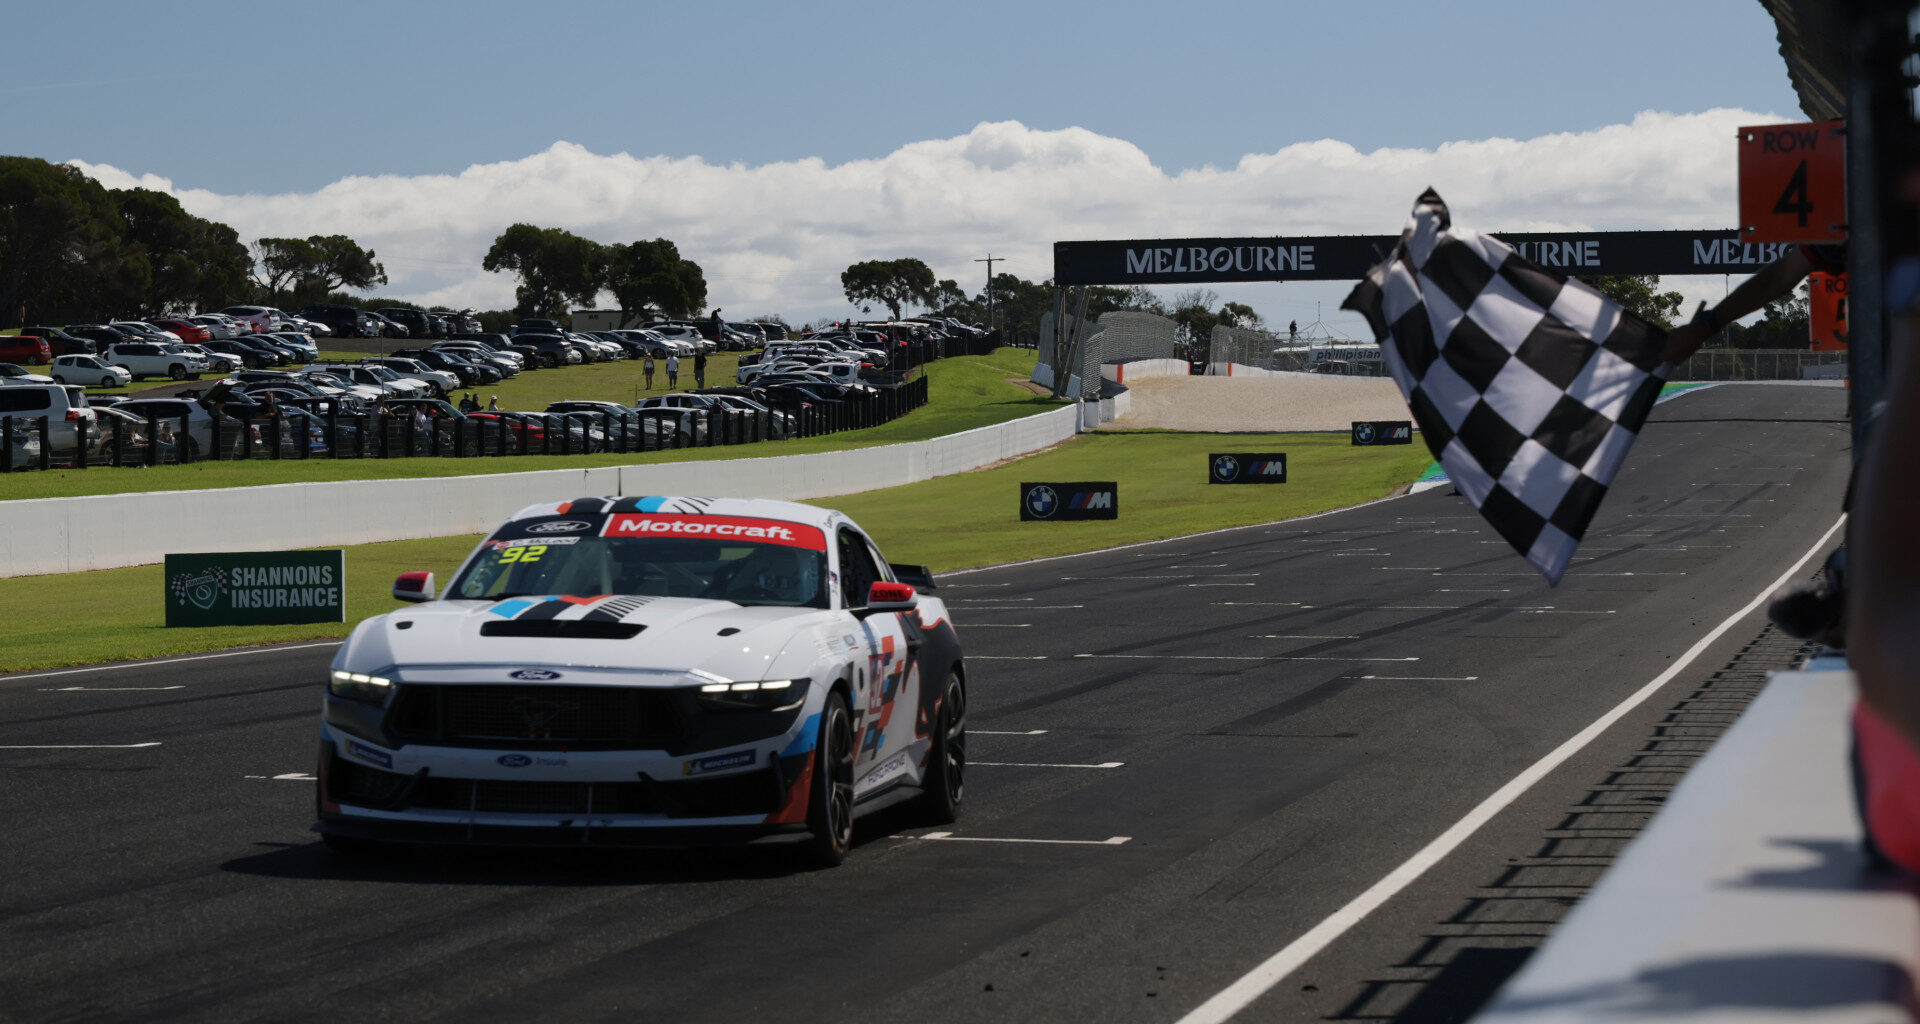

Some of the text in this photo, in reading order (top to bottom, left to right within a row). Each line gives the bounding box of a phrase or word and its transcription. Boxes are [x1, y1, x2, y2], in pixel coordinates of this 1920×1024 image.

[1762, 129, 1818, 153] ROW
[1772, 159, 1814, 227] 4
[1126, 245, 1315, 274] MELBOURNE
[1825, 278, 1846, 294] RO
[1316, 349, 1381, 361] phillipislan
[1262, 461, 1282, 475] M
[1087, 492, 1111, 508] M
[536, 522, 580, 532] Ford
[498, 545, 548, 564] 92
[231, 565, 333, 587] SHANNONS
[231, 587, 338, 608] INSURANCE
[872, 589, 905, 598] ZONE
[517, 670, 552, 679] Ford
